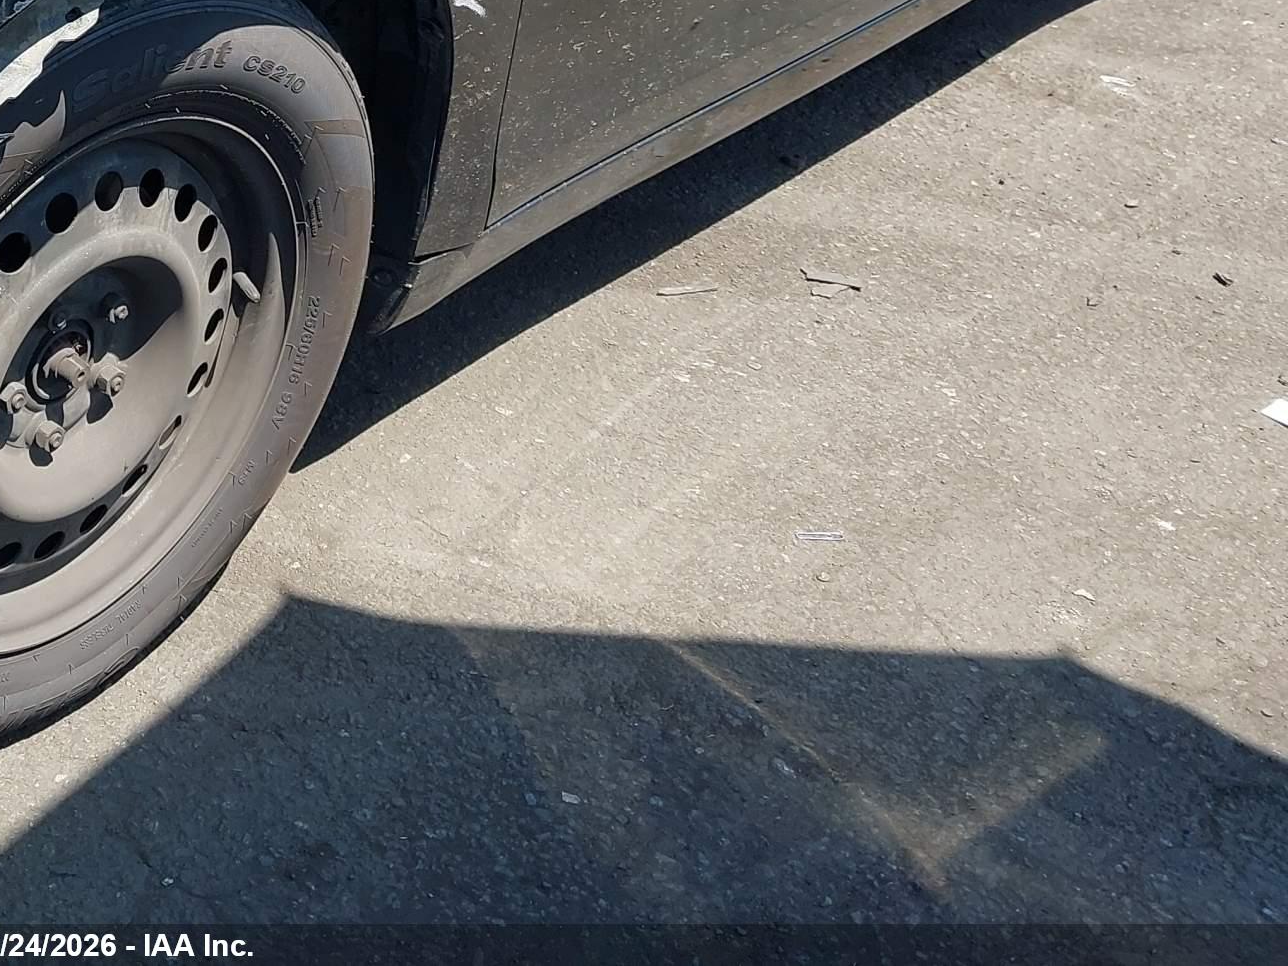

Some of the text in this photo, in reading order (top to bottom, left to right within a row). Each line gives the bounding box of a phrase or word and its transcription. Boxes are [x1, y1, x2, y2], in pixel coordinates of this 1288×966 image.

[71, 40, 307, 112] Salient CS210
[271, 392, 293, 430] 98V
